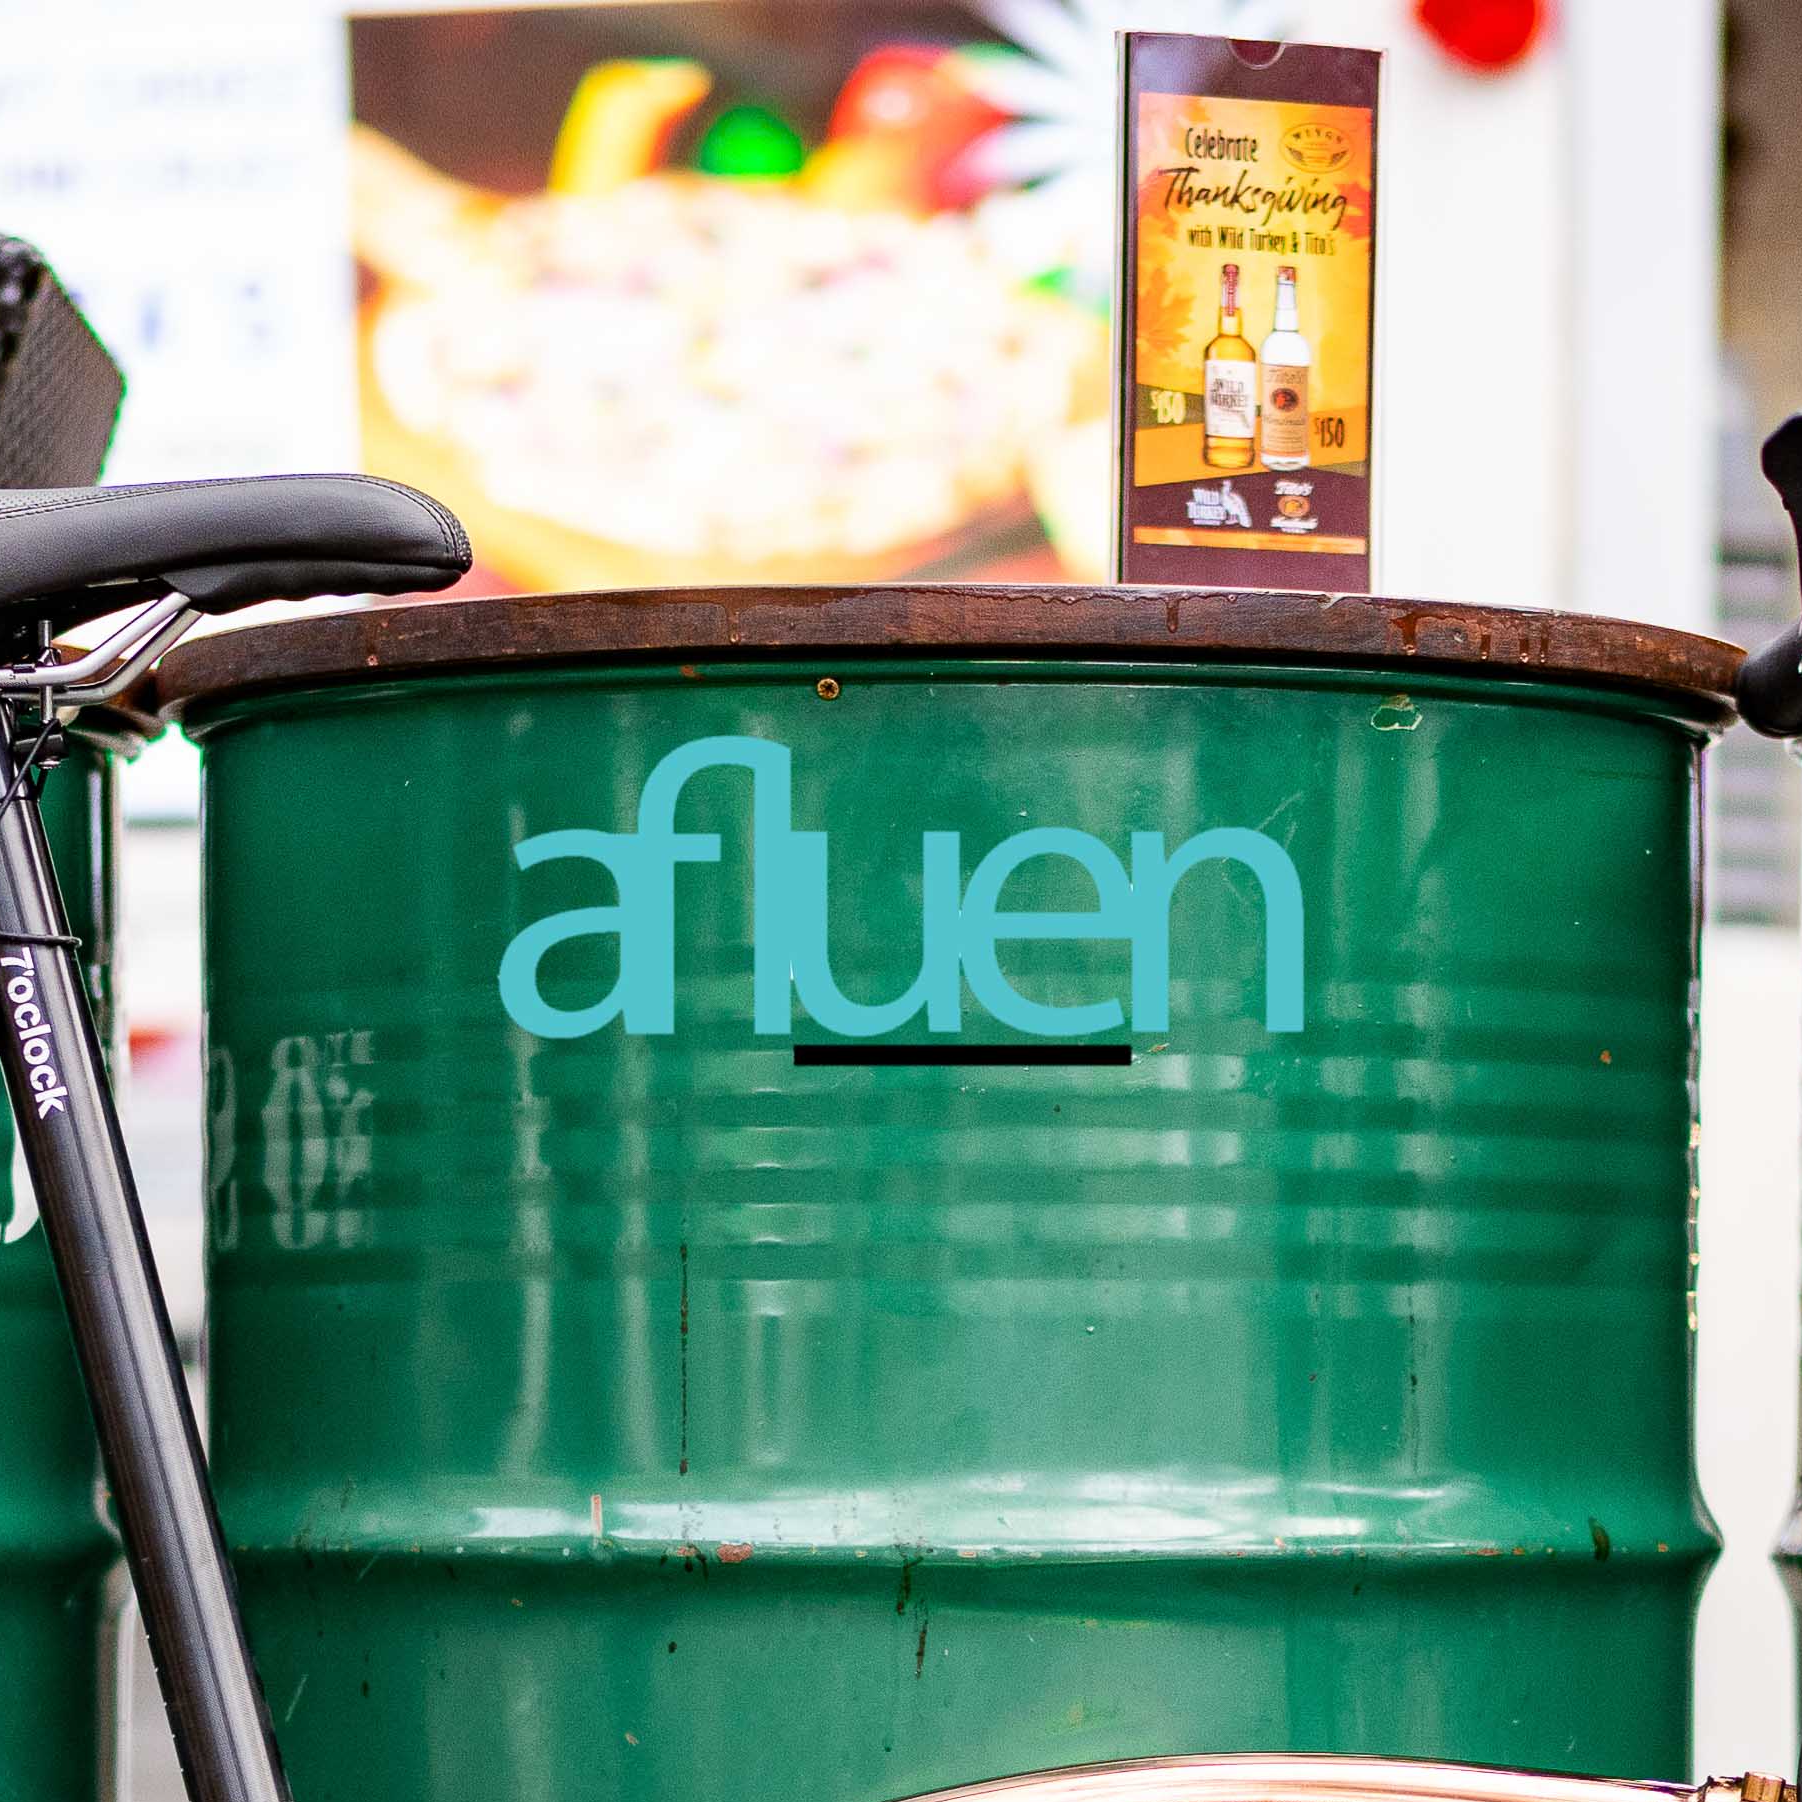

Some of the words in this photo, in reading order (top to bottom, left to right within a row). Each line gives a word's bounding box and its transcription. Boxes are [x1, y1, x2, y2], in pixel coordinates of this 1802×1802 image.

[1185, 127, 1260, 163] Celebrate
[1158, 165, 1348, 231] Thanksgiving
[1187, 225, 1213, 249] with
[1217, 226, 1245, 250] Wild
